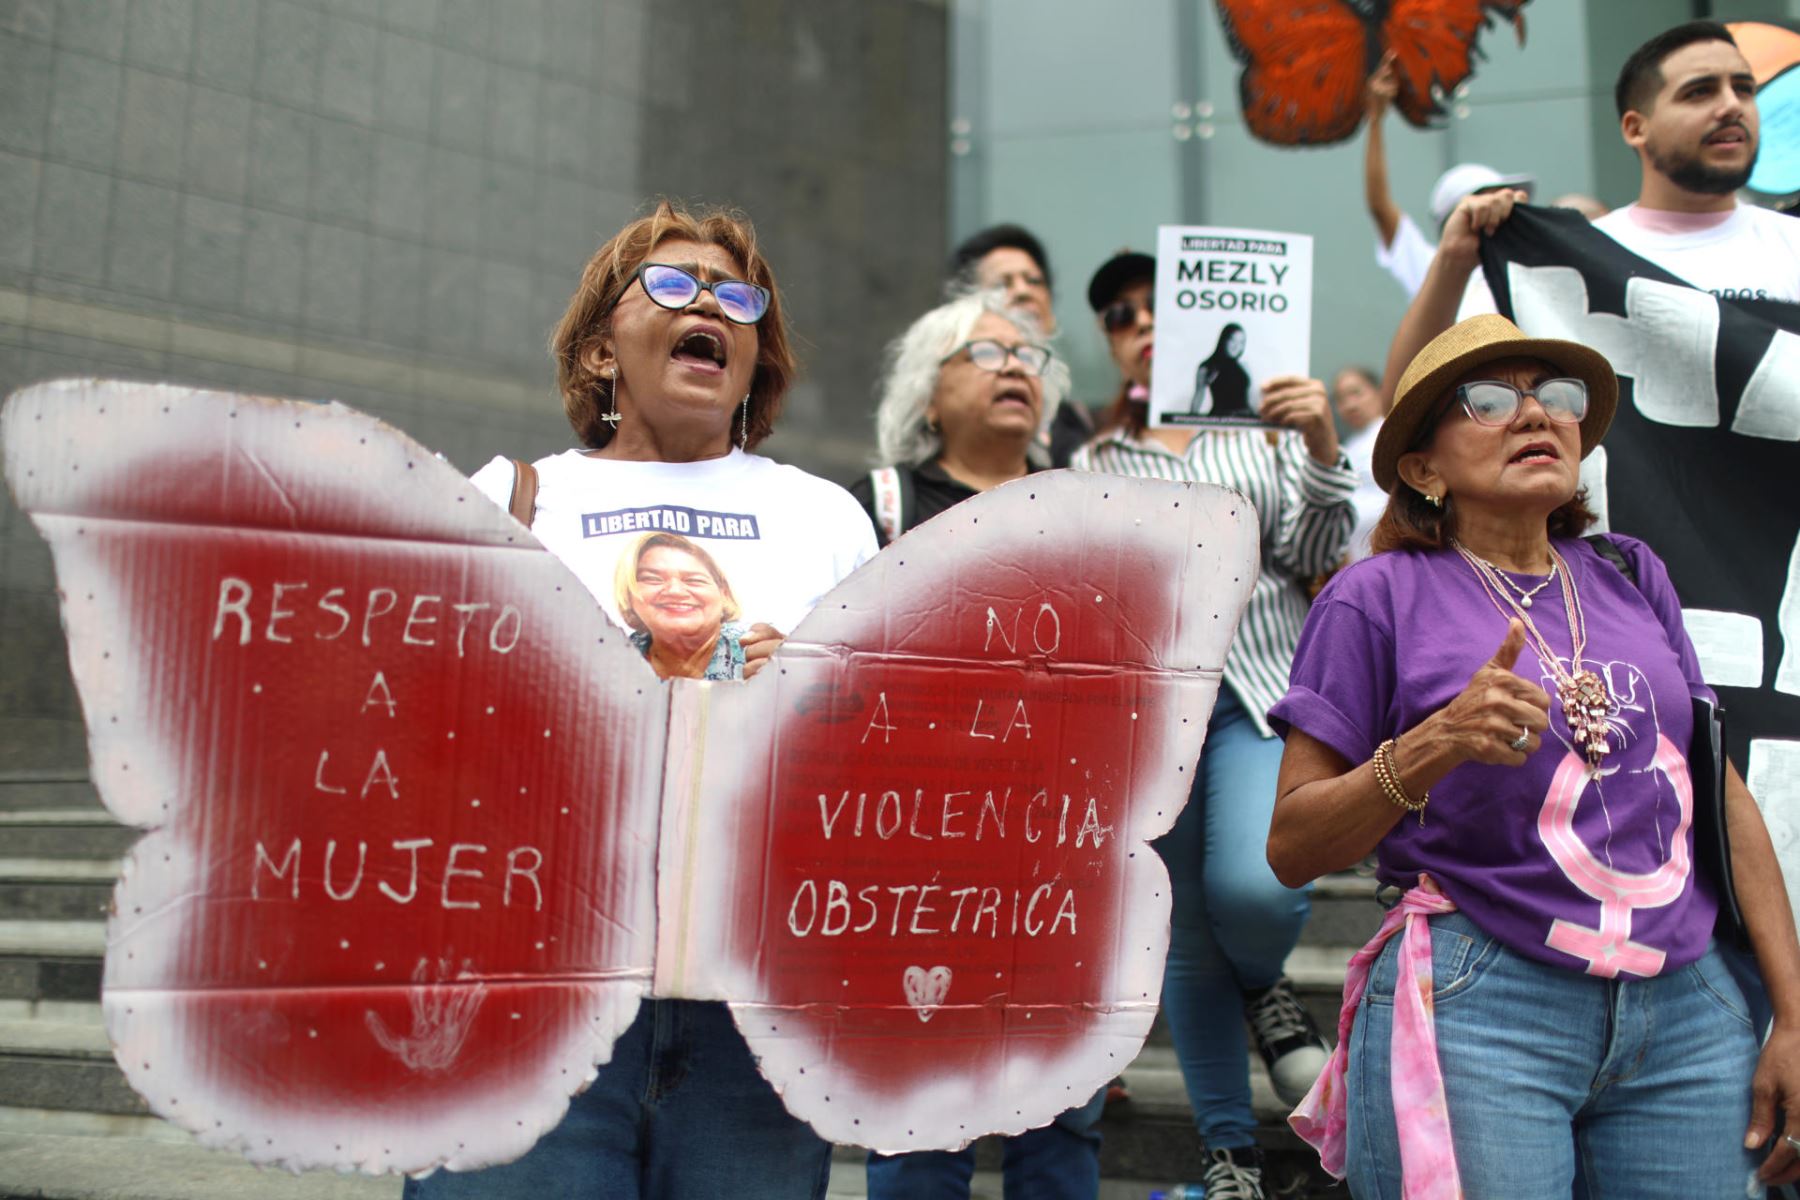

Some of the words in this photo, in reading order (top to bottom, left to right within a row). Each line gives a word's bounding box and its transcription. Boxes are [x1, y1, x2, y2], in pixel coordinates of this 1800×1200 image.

[1177, 260, 1289, 285] MEZLY
[1176, 290, 1288, 313] OSORIO
[588, 510, 690, 534] LIBERTAD
[696, 515, 755, 537] PARA
[213, 577, 522, 657] RESPETO
[984, 602, 1061, 654] NO
[361, 671, 397, 718] A
[861, 692, 898, 743] A
[969, 699, 1032, 743] LA
[315, 748, 399, 800] LA
[818, 787, 1104, 848] VIOLENCIA
[251, 838, 544, 911] MUJER
[788, 871, 1077, 938] OBSTÉTRICA
